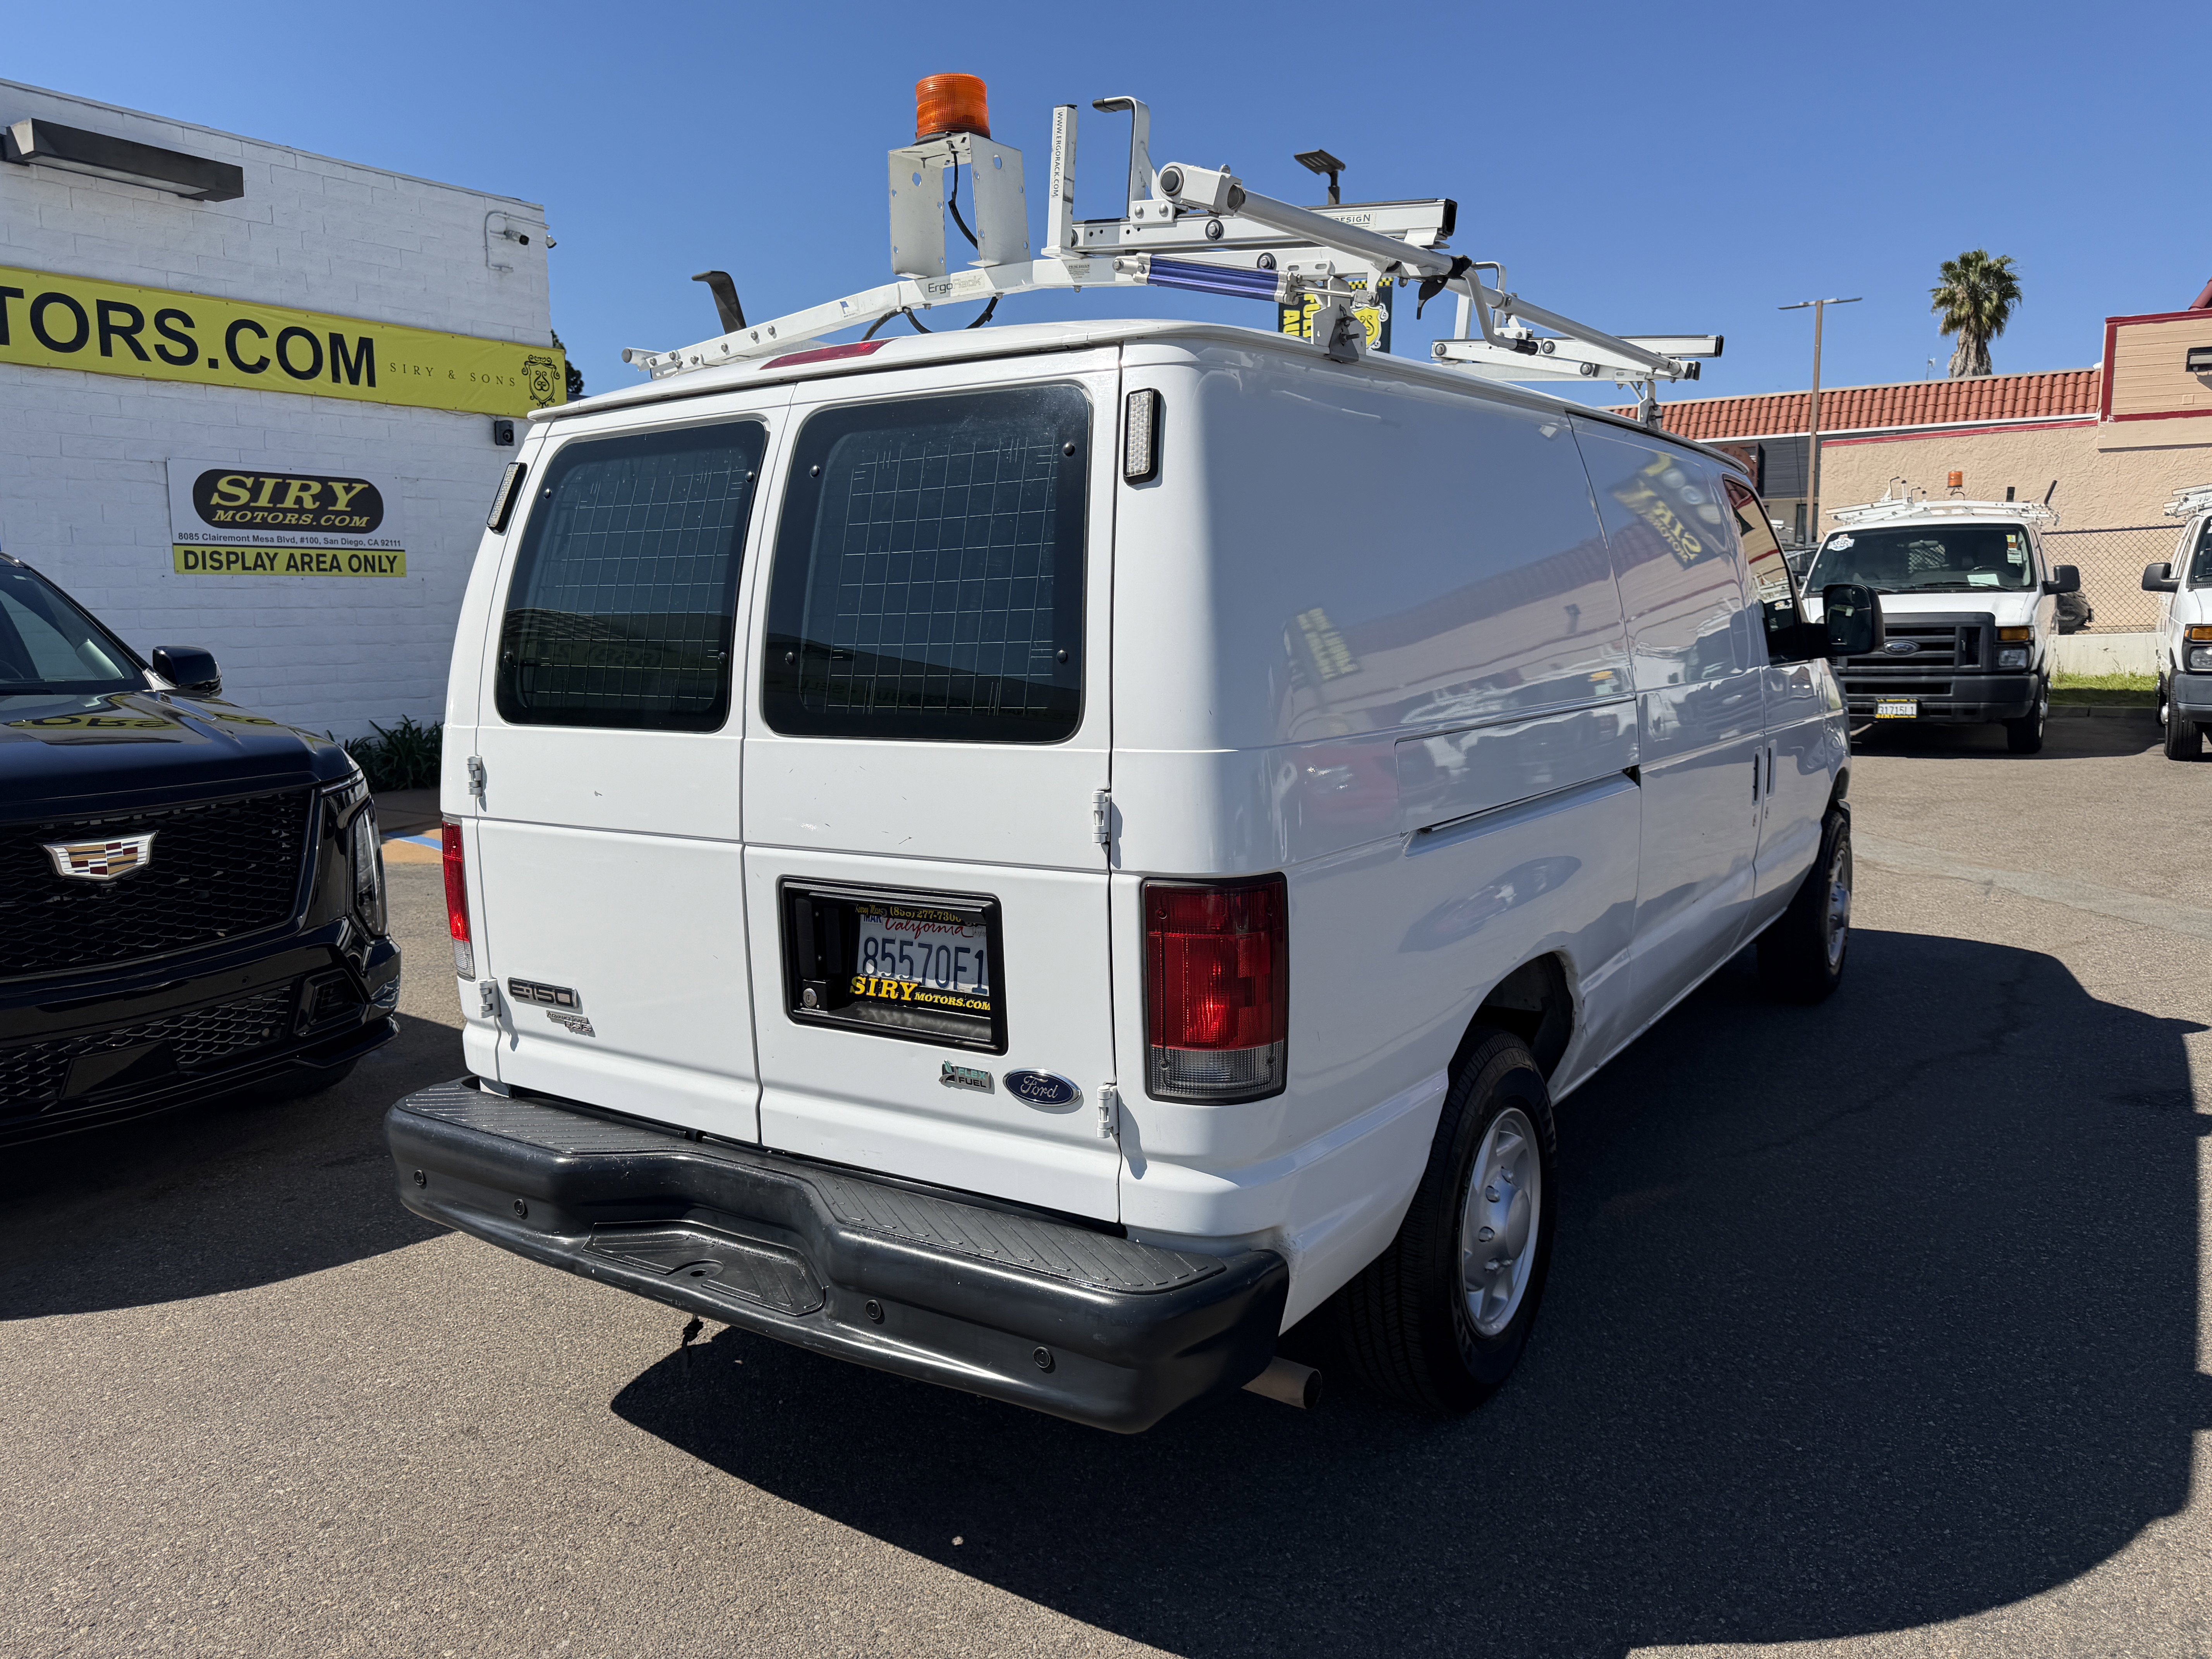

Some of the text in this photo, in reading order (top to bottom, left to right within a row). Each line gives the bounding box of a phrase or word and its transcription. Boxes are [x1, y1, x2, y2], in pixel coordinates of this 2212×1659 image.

[1053, 112, 1063, 197] WWW.ERGORACK.COM
[928, 276, 981, 294] ErgoRack
[390, 362, 515, 386] SIRY & SONS
[210, 475, 369, 511] SIRY
[212, 510, 370, 527] MOTORS.COM
[178, 532, 199, 541] 8085
[202, 533, 250, 542] Clairemont
[277, 536, 297, 544] Blvd,
[300, 537, 321, 545] #100,
[341, 538, 366, 547] Diego,
[183, 550, 398, 573] DISPLAY AREA ONLY
[885, 917, 974, 939] California
[862, 937, 988, 994] 85570F1
[850, 976, 991, 1011] SIRY MOTORS.COM
[958, 1068, 987, 1080] FLEX
[959, 1077, 987, 1088] FUEL
[1020, 1076, 1058, 1098] Ford
